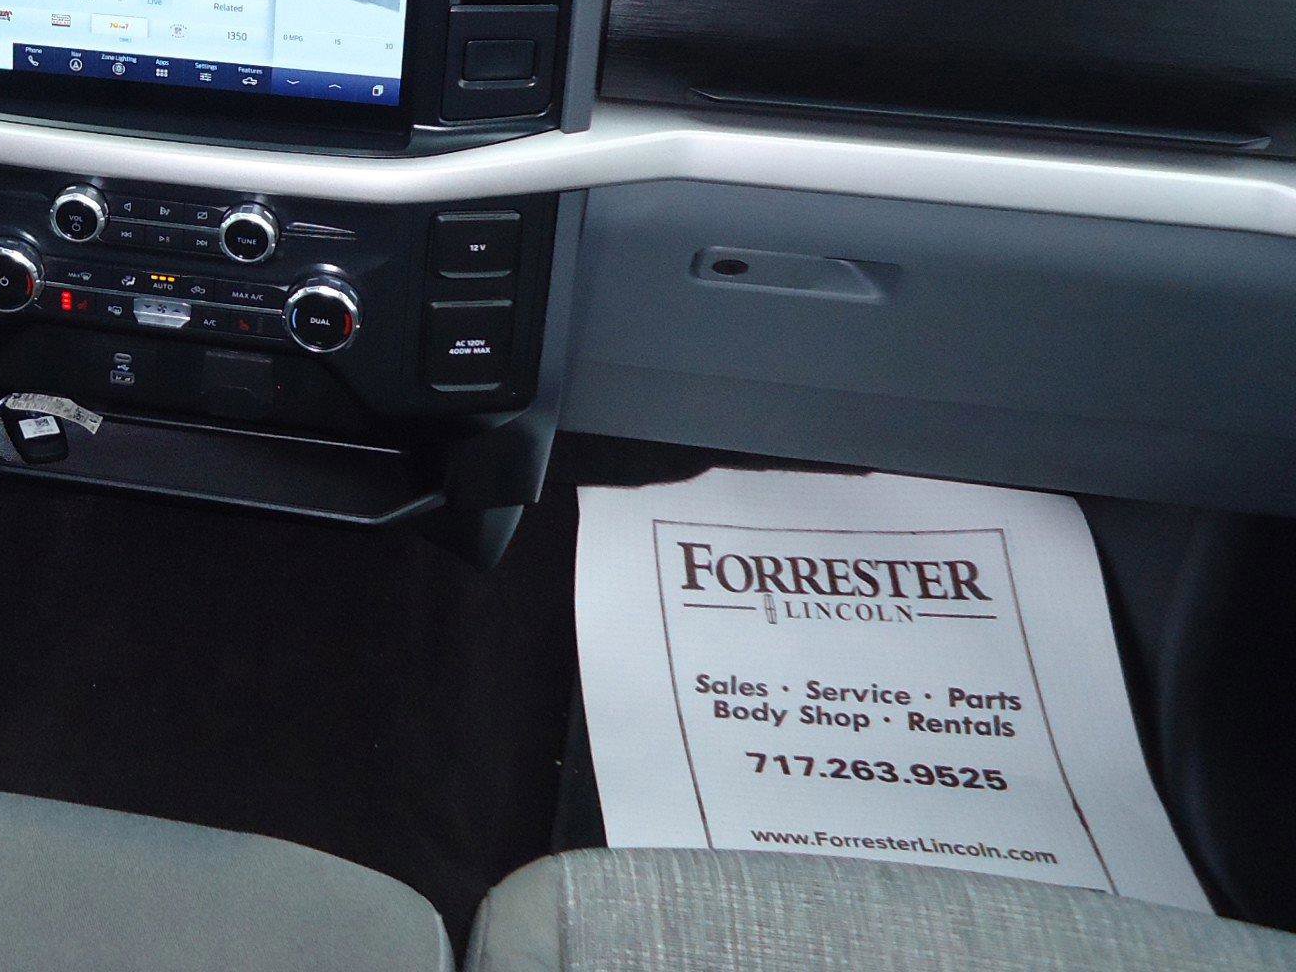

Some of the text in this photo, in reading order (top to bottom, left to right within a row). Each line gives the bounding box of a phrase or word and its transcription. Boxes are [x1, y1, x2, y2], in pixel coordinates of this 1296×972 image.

[214, 2, 244, 13] Related
[227, 31, 248, 42] 1350
[25, 46, 43, 55] Phone
[115, 54, 138, 64] Lighting
[155, 58, 170, 66] Apps
[194, 62, 218, 72] Settings
[238, 66, 263, 75] Features
[68, 214, 84, 223] VOL
[236, 236, 258, 246] TUNE
[469, 244, 486, 252] 12 V
[152, 282, 174, 291] AUTO
[232, 291, 264, 302] MAX A/C
[204, 318, 217, 327] A/C
[310, 317, 331, 326] DUAL
[456, 339, 486, 348] AC 120V
[448, 347, 491, 356] 400W MAX
[676, 541, 994, 601] FORRESTER
[784, 601, 915, 623] LINCOLN
[695, 673, 1023, 711] Sales Service Parts
[713, 699, 1016, 738] Body Shop Rentals
[745, 751, 1009, 792] 717.263.9525
[751, 829, 1058, 864] www.ForresterLincoln.com
